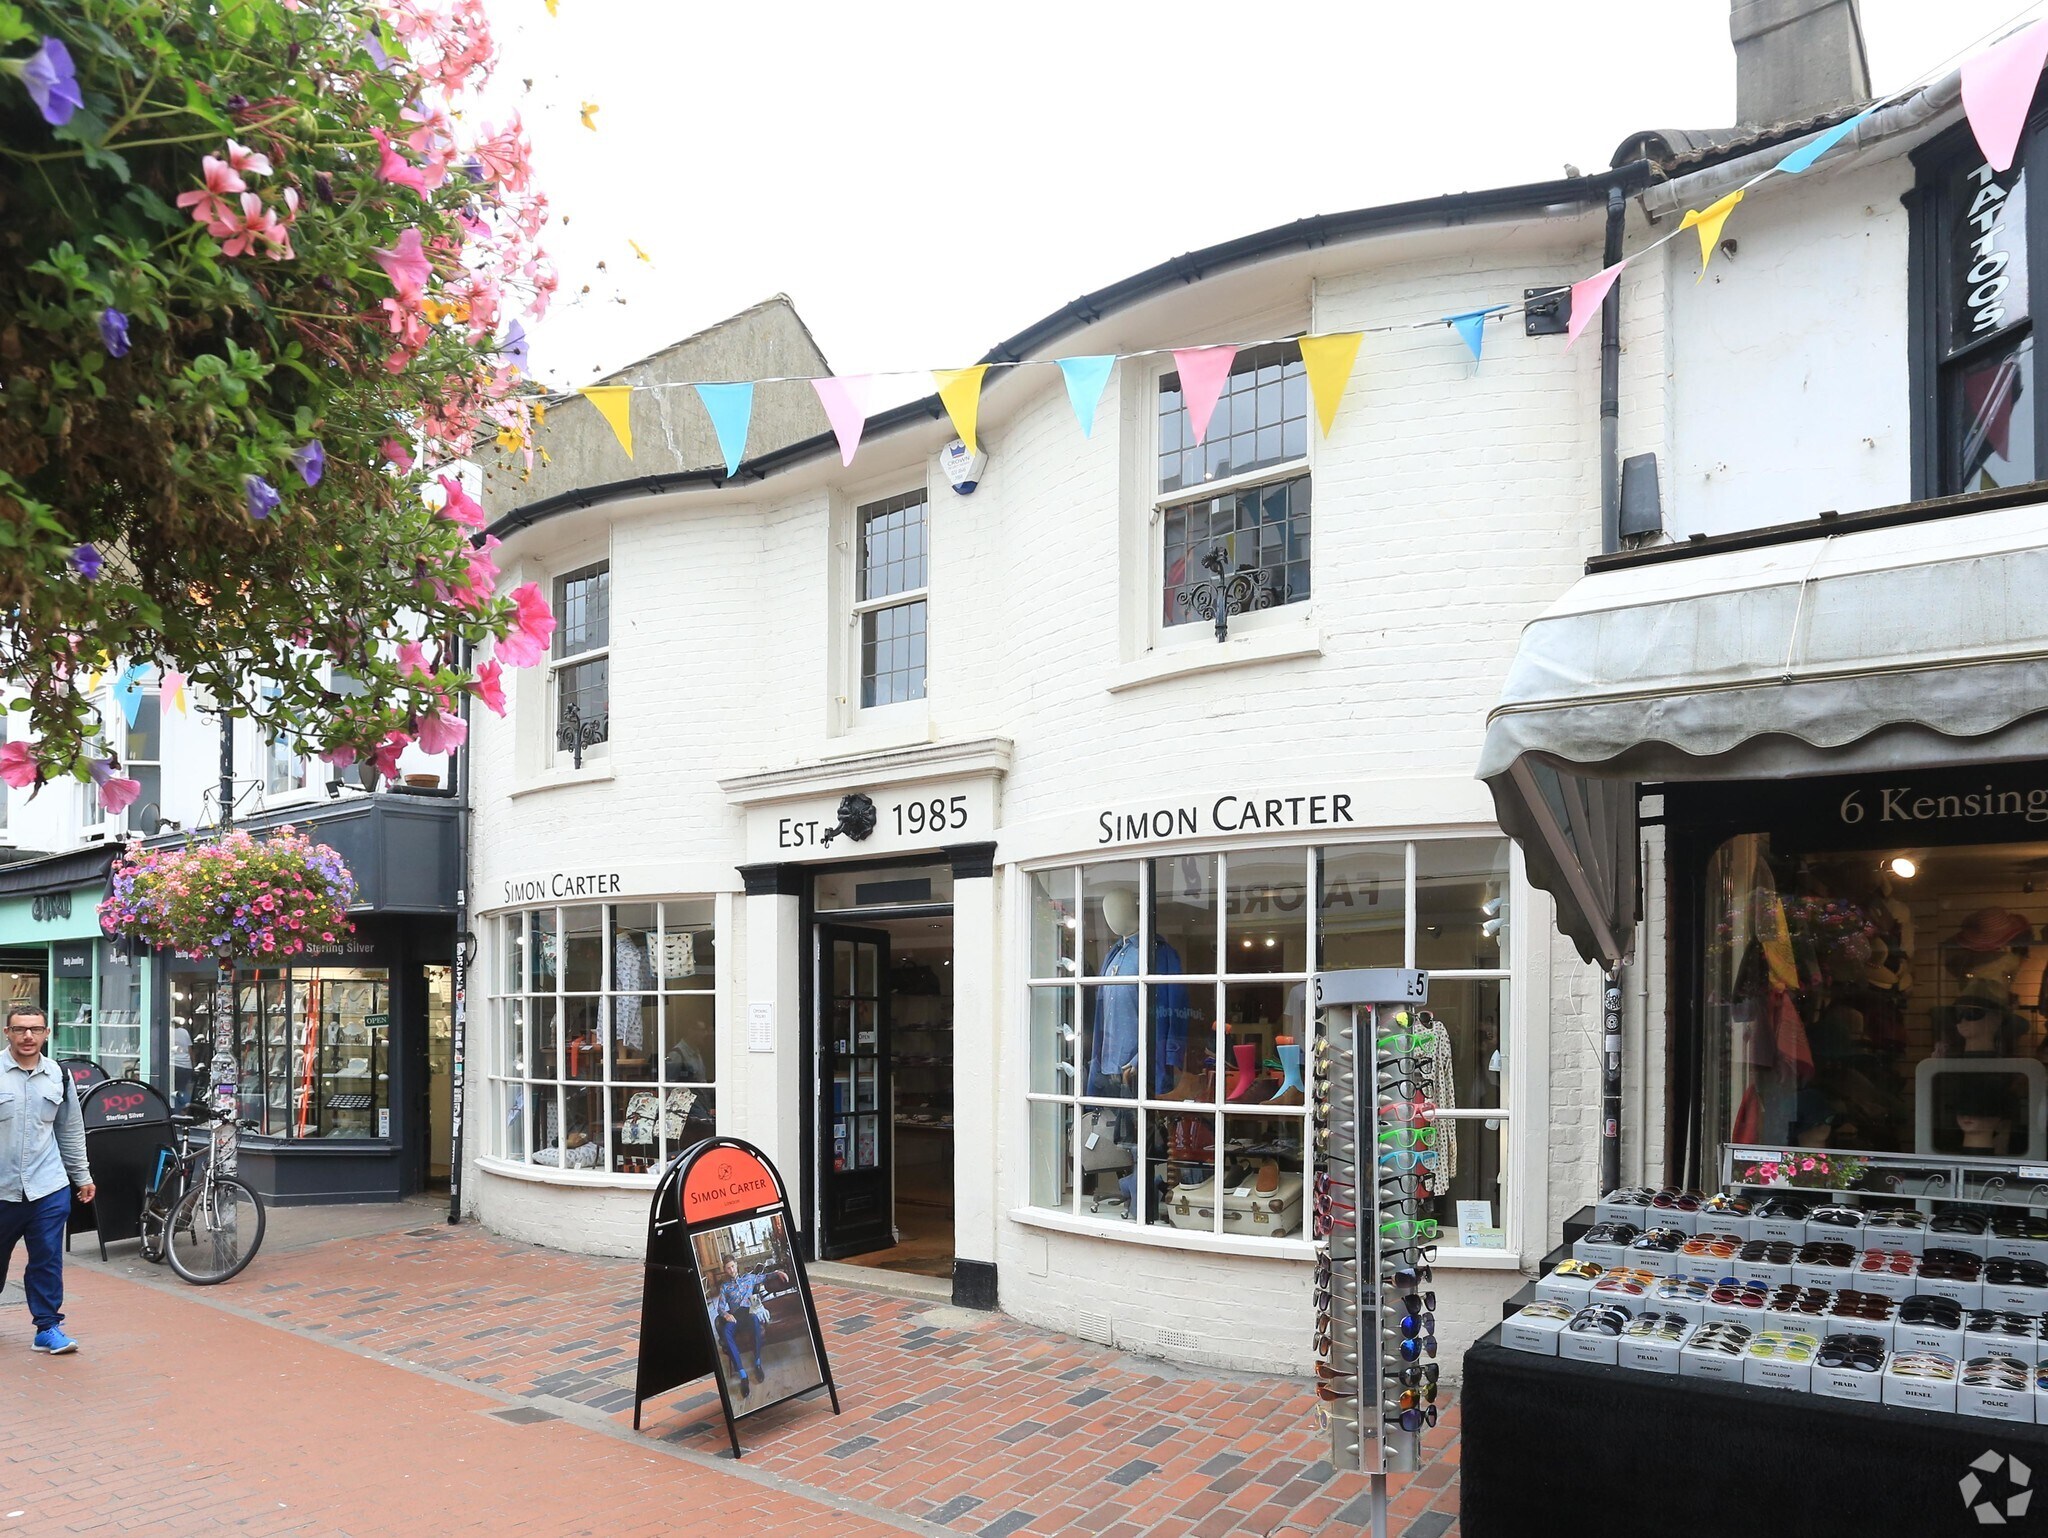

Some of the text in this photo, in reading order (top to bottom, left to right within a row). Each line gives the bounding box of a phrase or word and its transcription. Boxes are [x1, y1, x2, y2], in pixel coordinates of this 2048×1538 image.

[1967, 162, 2010, 332] TATTOOS
[1840, 789, 1864, 824] 6
[892, 795, 968, 836] 1985
[1098, 794, 1354, 844] SIMON CARTER
[504, 873, 621, 903] SIMON CARTER
[306, 941, 375, 955] Sterling Silver
[366, 1016, 387, 1025] OPEN
[105, 1112, 128, 1122] Sterling
[690, 1178, 767, 1205] SIMON CARTER
[1987, 1350, 2013, 1358] POLICE
[1833, 1380, 1858, 1389] PRADA
[1905, 1390, 1933, 1399] DIESEL
[1982, 1399, 2009, 1408] POLICE
